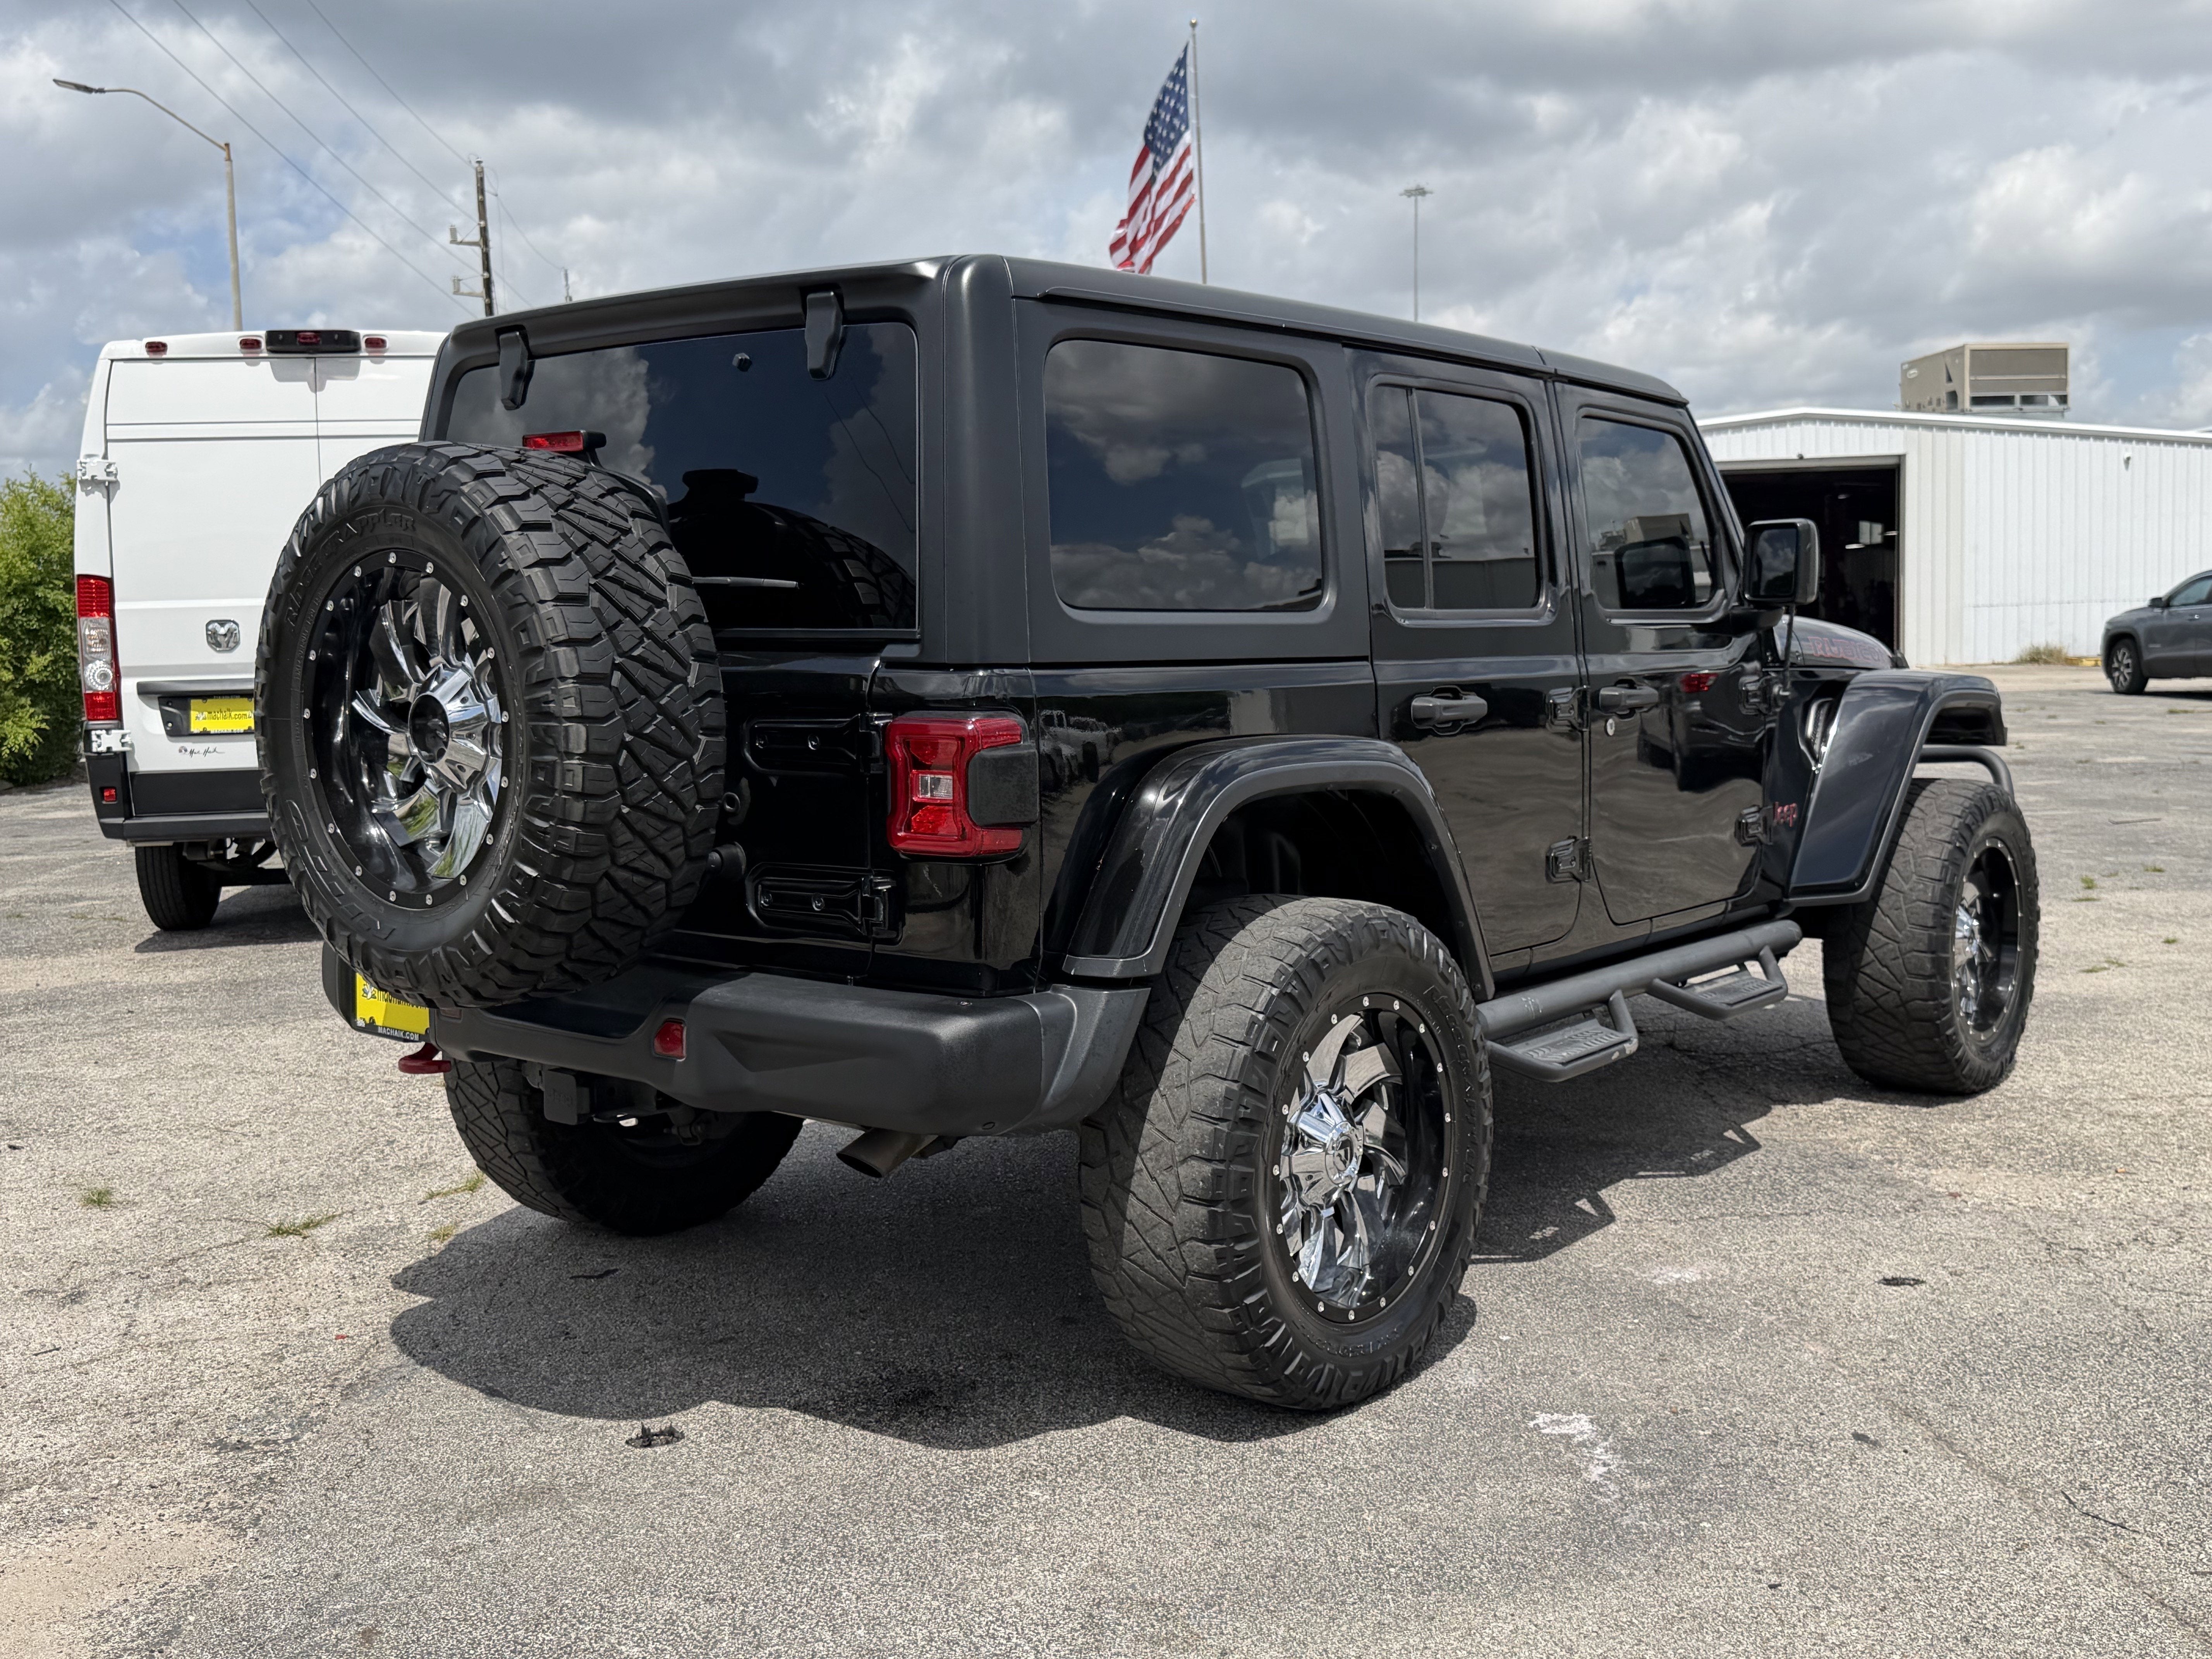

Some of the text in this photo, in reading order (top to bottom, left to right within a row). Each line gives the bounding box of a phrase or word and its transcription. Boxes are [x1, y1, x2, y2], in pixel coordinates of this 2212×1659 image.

[320, 508, 417, 557] GRAPPLER
[1774, 801, 1797, 827] Jeep
[378, 1026, 419, 1041] MACHAIK.COM
